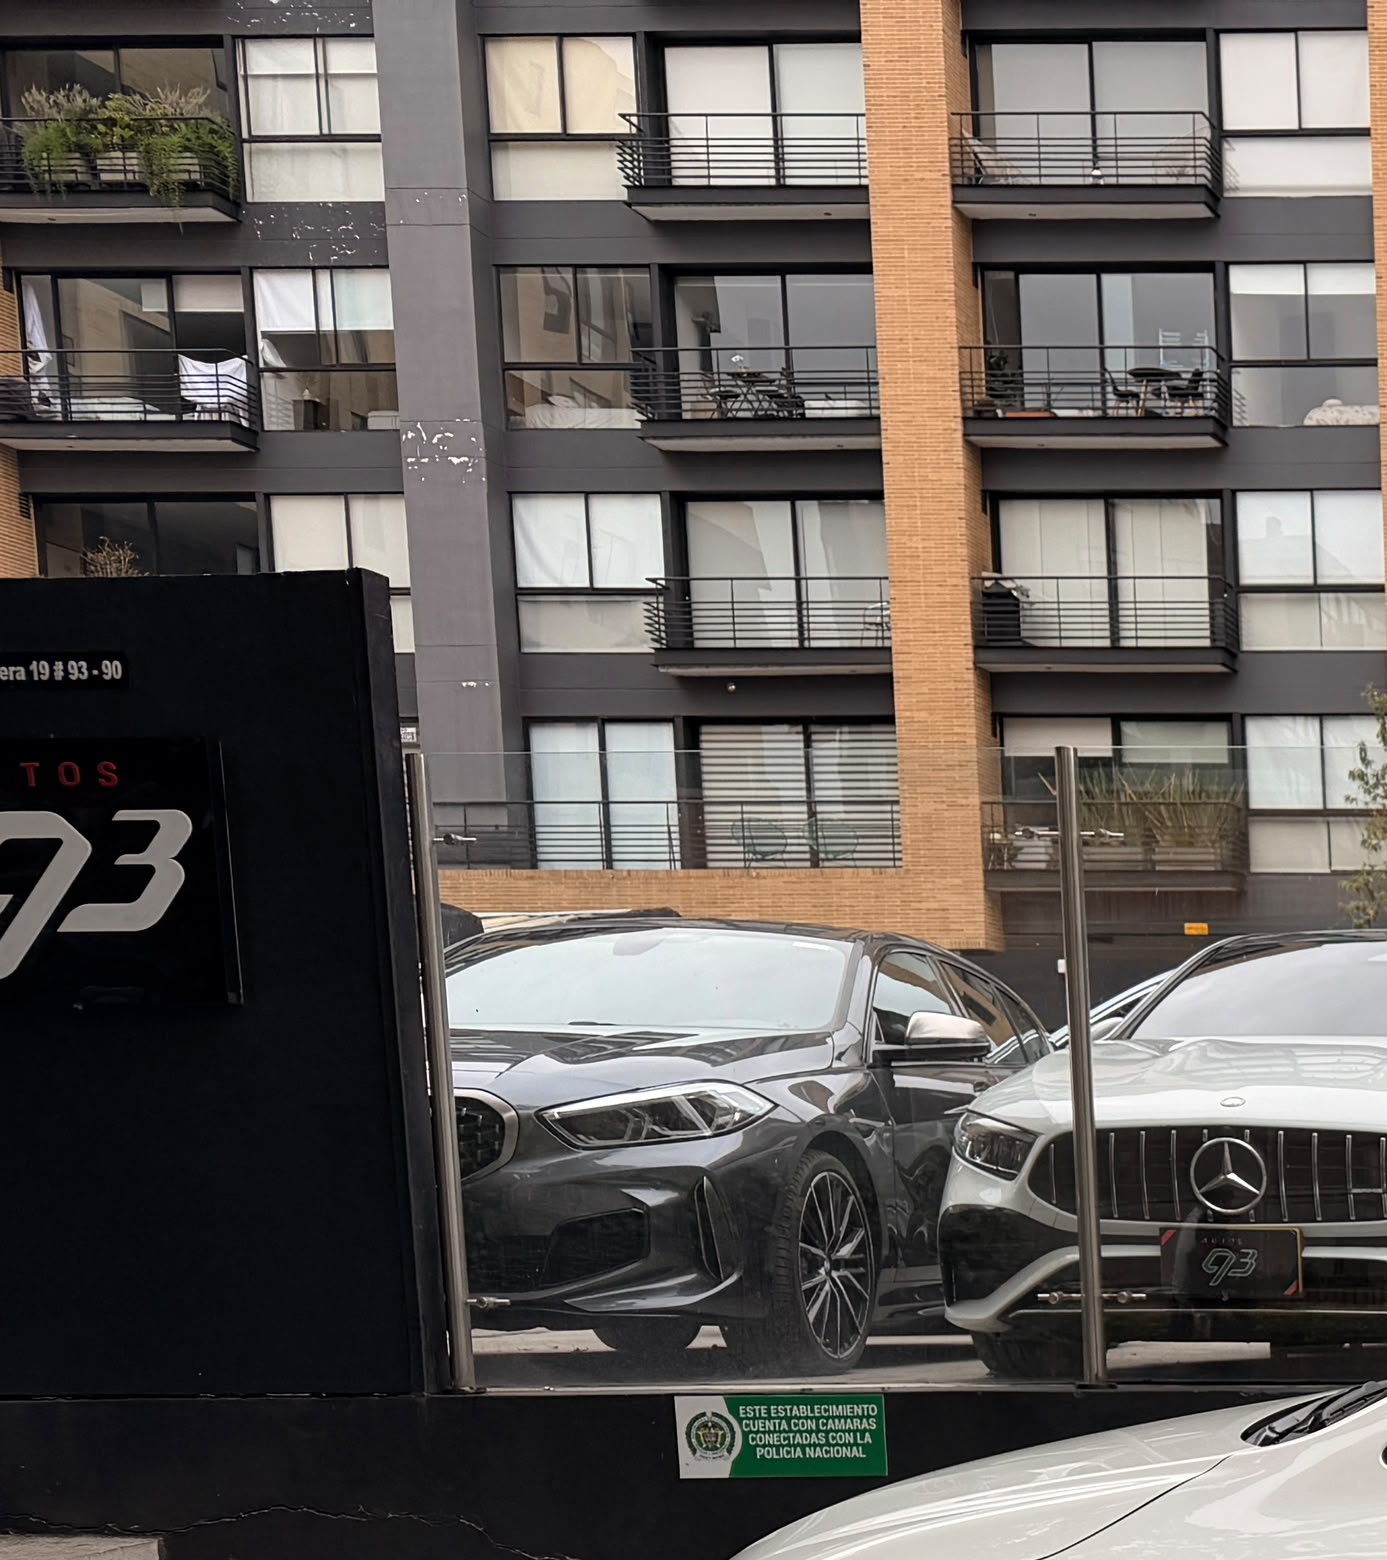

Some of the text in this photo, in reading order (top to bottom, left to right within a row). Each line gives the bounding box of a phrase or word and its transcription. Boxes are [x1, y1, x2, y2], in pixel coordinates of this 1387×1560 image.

[29, 660, 50, 681] 19
[53, 661, 64, 681] #
[67, 660, 88, 681] 93
[101, 660, 122, 681] 90
[1202, 1248, 1258, 1286] 93
[739, 1404, 878, 1417] ESTE ESTABLECIMIENTO
[742, 1418, 877, 1431] CUENTA CON CAMARAS
[748, 1432, 872, 1445] CONECTADAS CON LA
[756, 1446, 867, 1459] POLICIA NACIONAL
